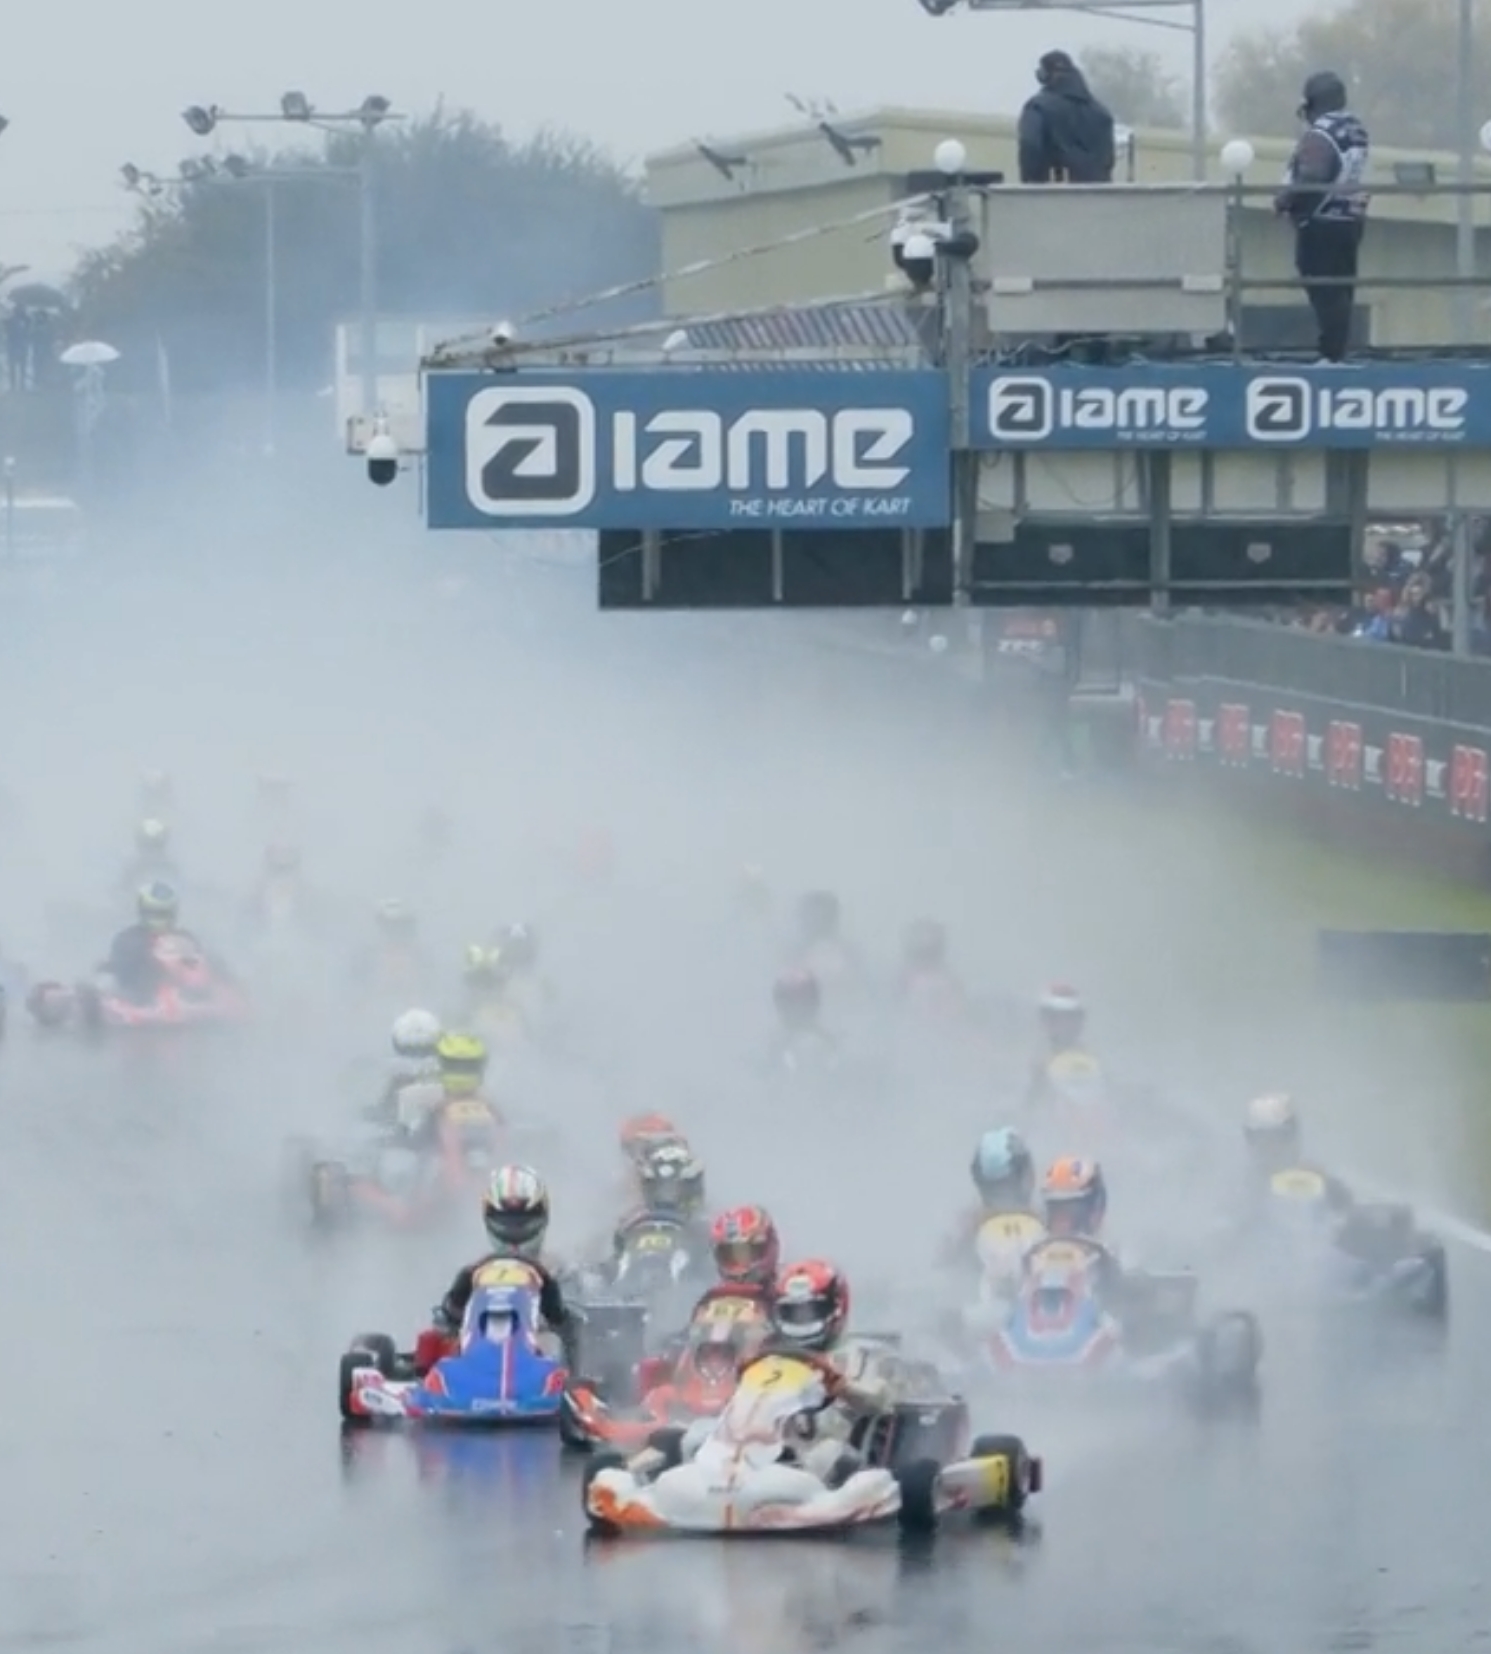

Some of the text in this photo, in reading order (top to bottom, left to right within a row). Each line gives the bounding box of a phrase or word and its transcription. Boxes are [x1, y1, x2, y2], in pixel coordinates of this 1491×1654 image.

[729, 497, 911, 517] THE HEART OF KART
